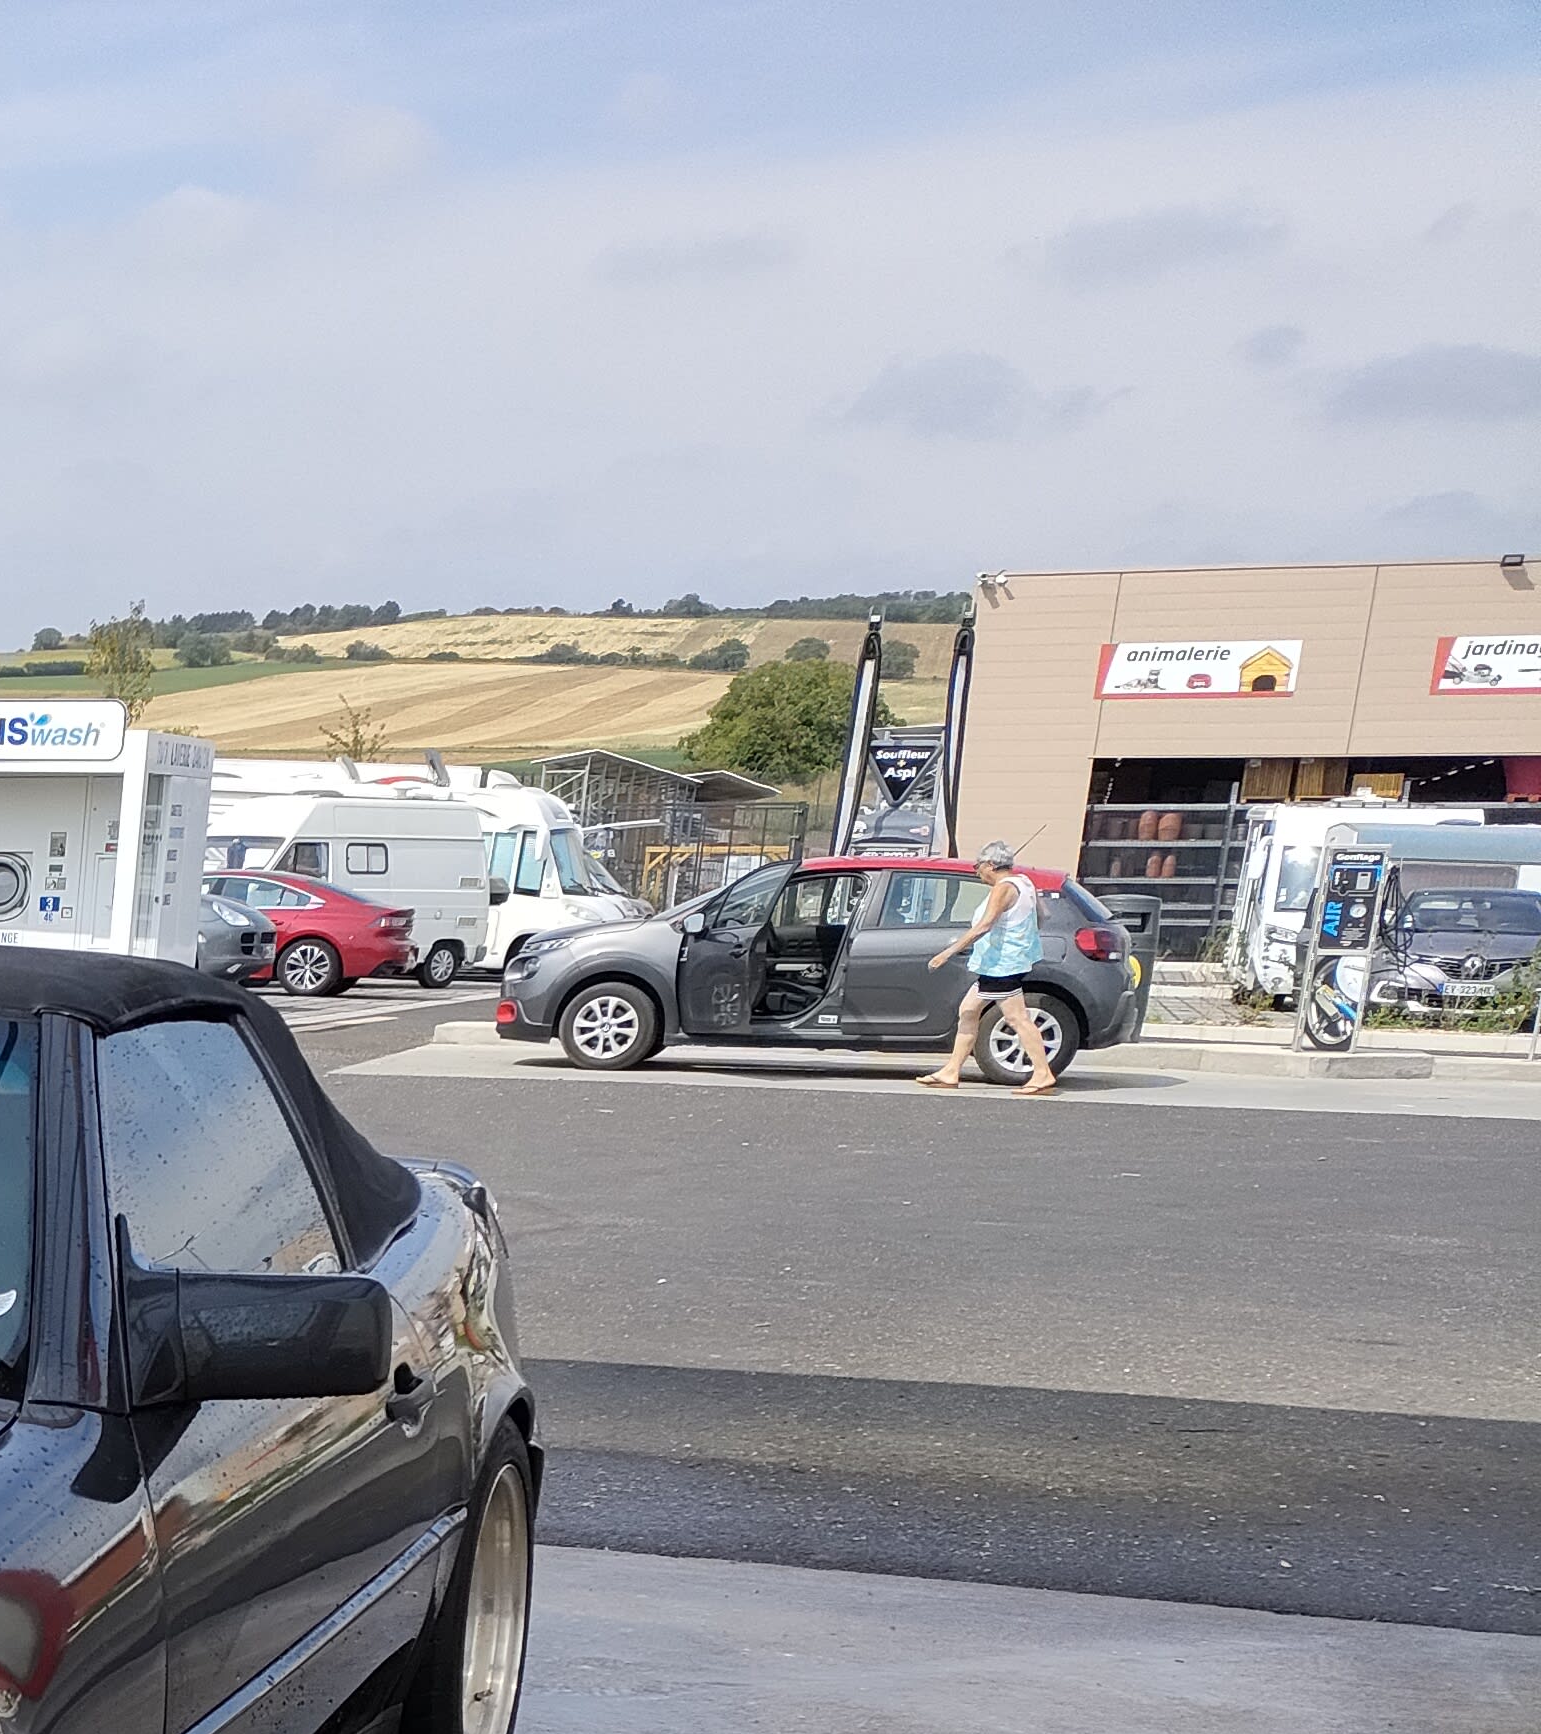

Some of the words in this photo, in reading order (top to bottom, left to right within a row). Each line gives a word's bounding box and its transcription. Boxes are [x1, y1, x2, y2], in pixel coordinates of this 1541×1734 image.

[1126, 646, 1231, 662] animalerie
[1461, 640, 1541, 660] jardina
[876, 750, 931, 760] Souffleur
[884, 767, 917, 781] Aspi
[1336, 853, 1381, 863] Gonflage
[46, 898, 53, 911] 3
[1323, 901, 1344, 937] AIR
